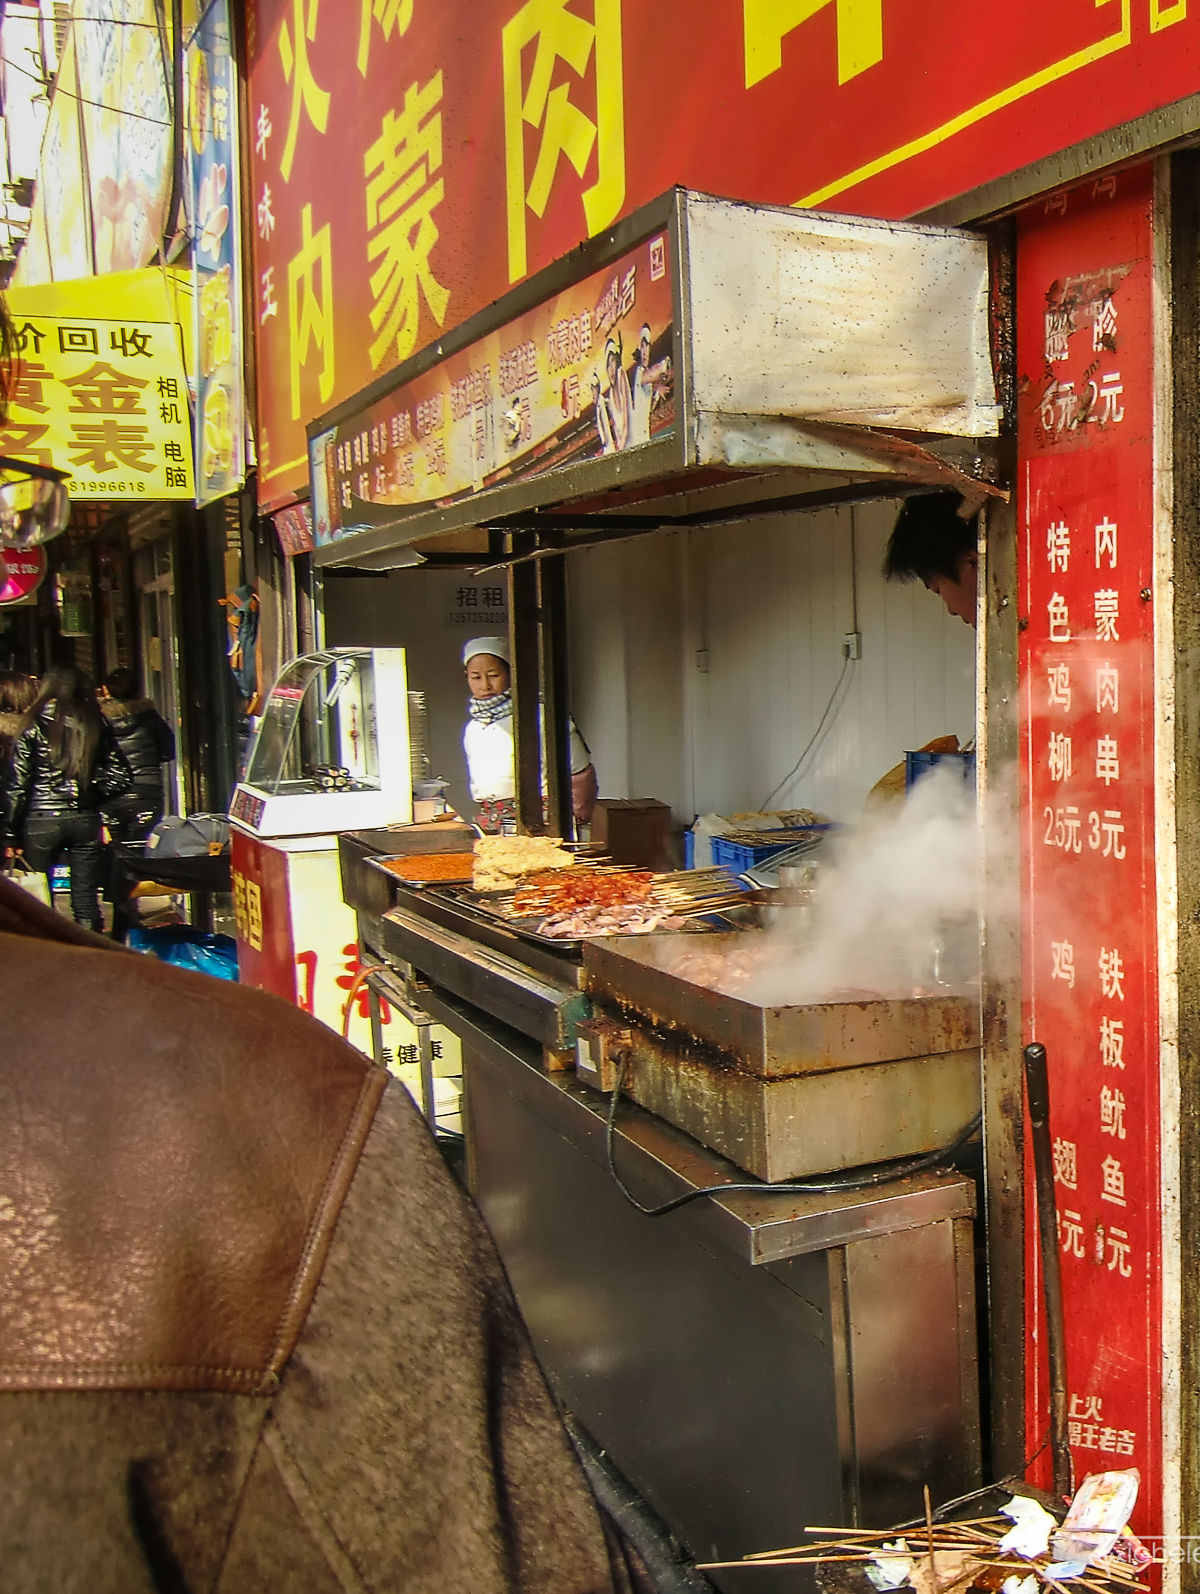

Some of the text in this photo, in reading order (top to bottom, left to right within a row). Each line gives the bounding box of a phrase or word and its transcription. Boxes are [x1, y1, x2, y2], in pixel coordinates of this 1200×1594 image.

[157, 376, 188, 489] 相机 电脑
[457, 587, 504, 608] 招租
[1046, 521, 1072, 783] 特色鸡柳
[1093, 516, 1120, 787] 内蒙肉串
[1087, 809, 1127, 861] 3元
[1098, 946, 1127, 1208] 铁板鱿鱼
